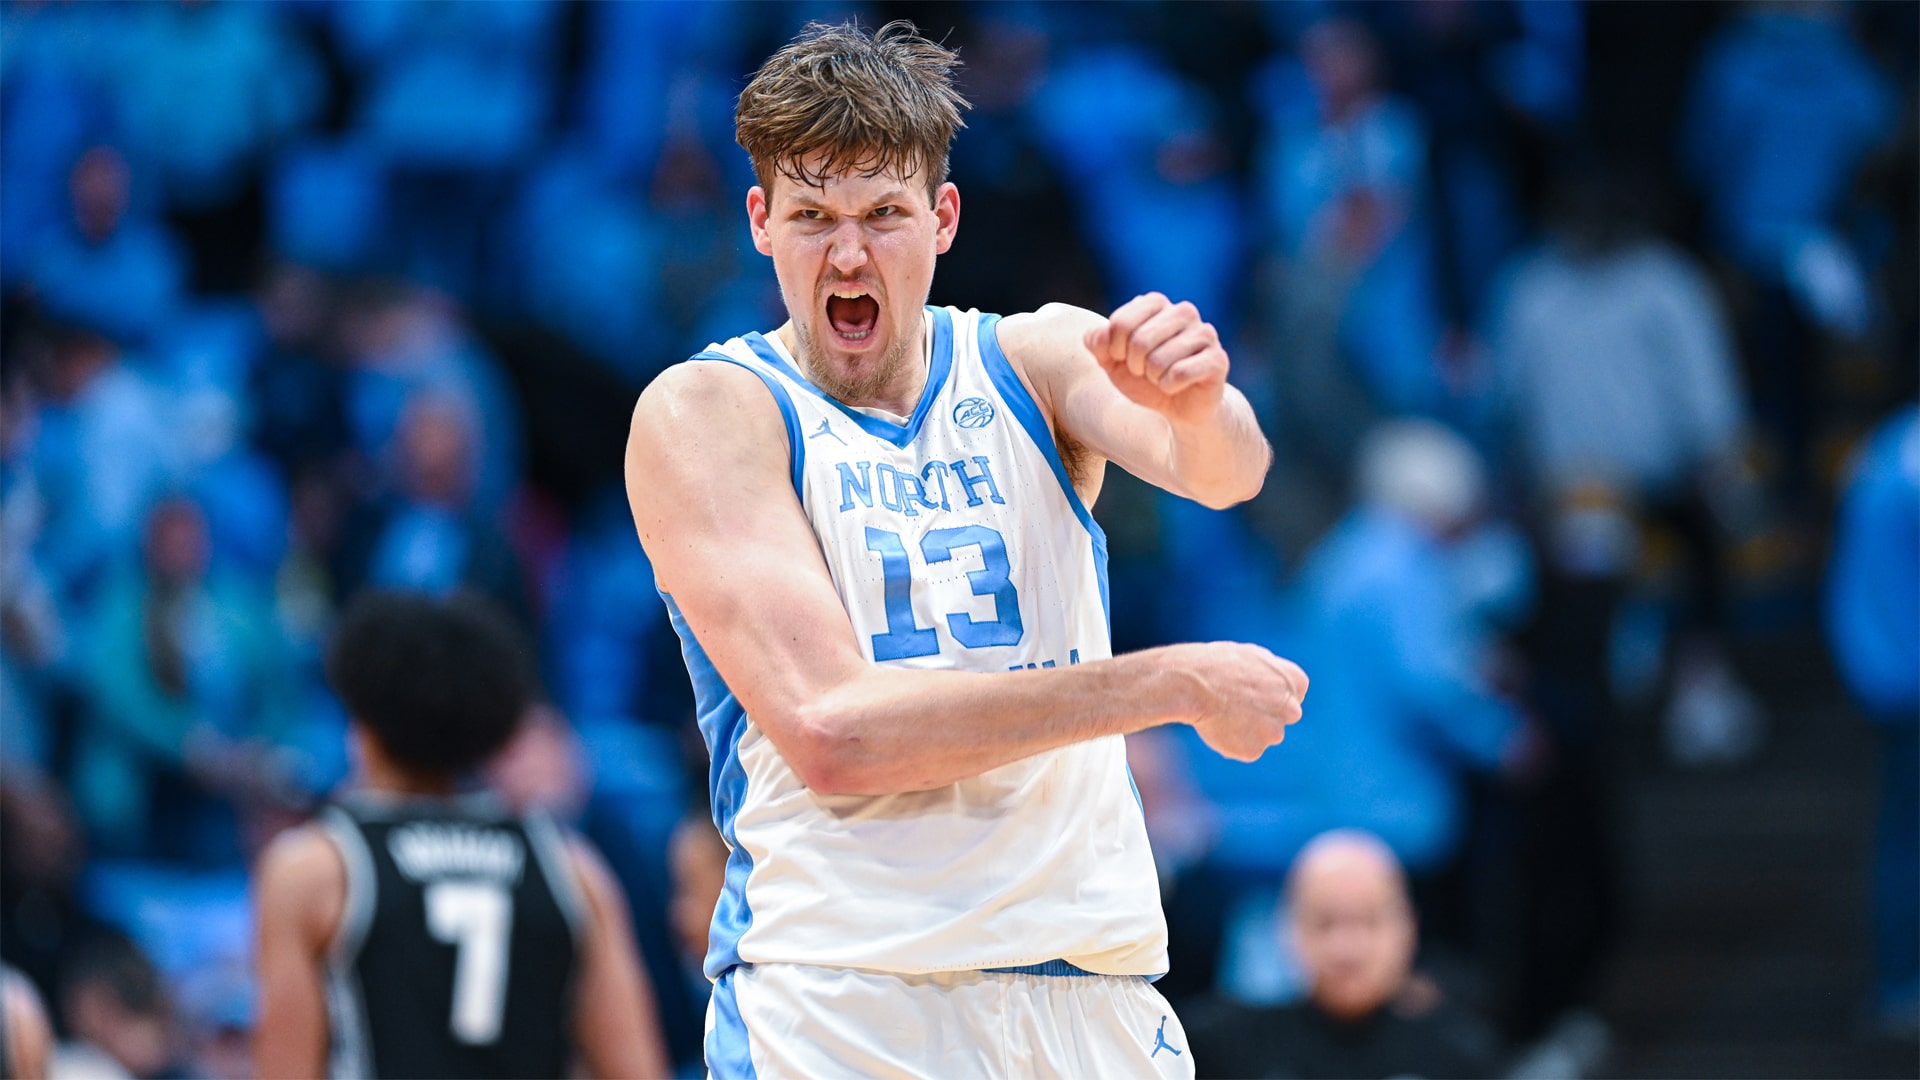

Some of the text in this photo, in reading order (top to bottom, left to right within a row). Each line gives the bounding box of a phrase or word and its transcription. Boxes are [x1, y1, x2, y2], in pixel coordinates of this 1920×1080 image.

[959, 401, 990, 421] ACC
[835, 455, 1006, 517] NORTH
[864, 524, 1024, 662] 13
[425, 882, 513, 1043] 7
